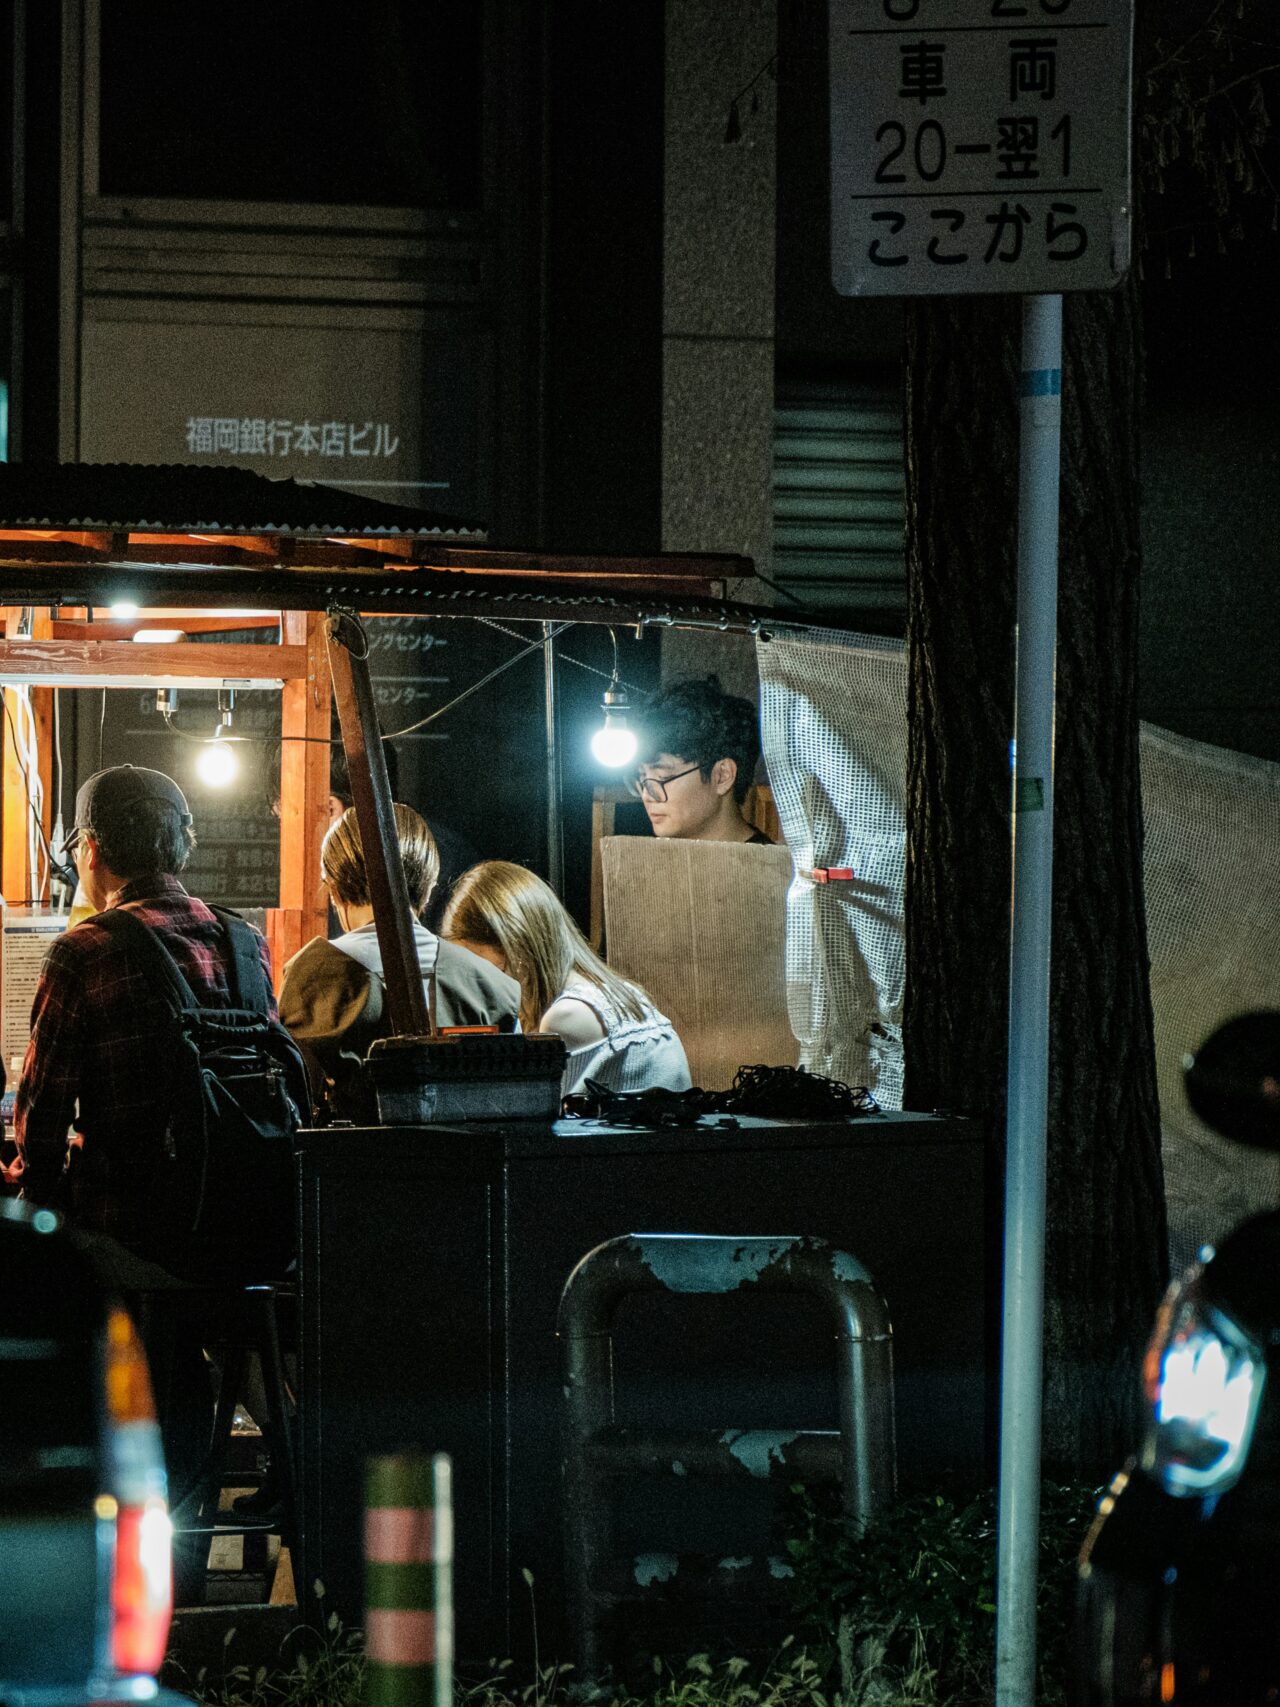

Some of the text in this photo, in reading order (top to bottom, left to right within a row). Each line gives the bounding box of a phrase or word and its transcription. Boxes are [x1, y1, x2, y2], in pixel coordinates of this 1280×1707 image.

[869, 202, 1088, 267] ここから
[186, 416, 399, 457] 福岡銀行本店ビル
